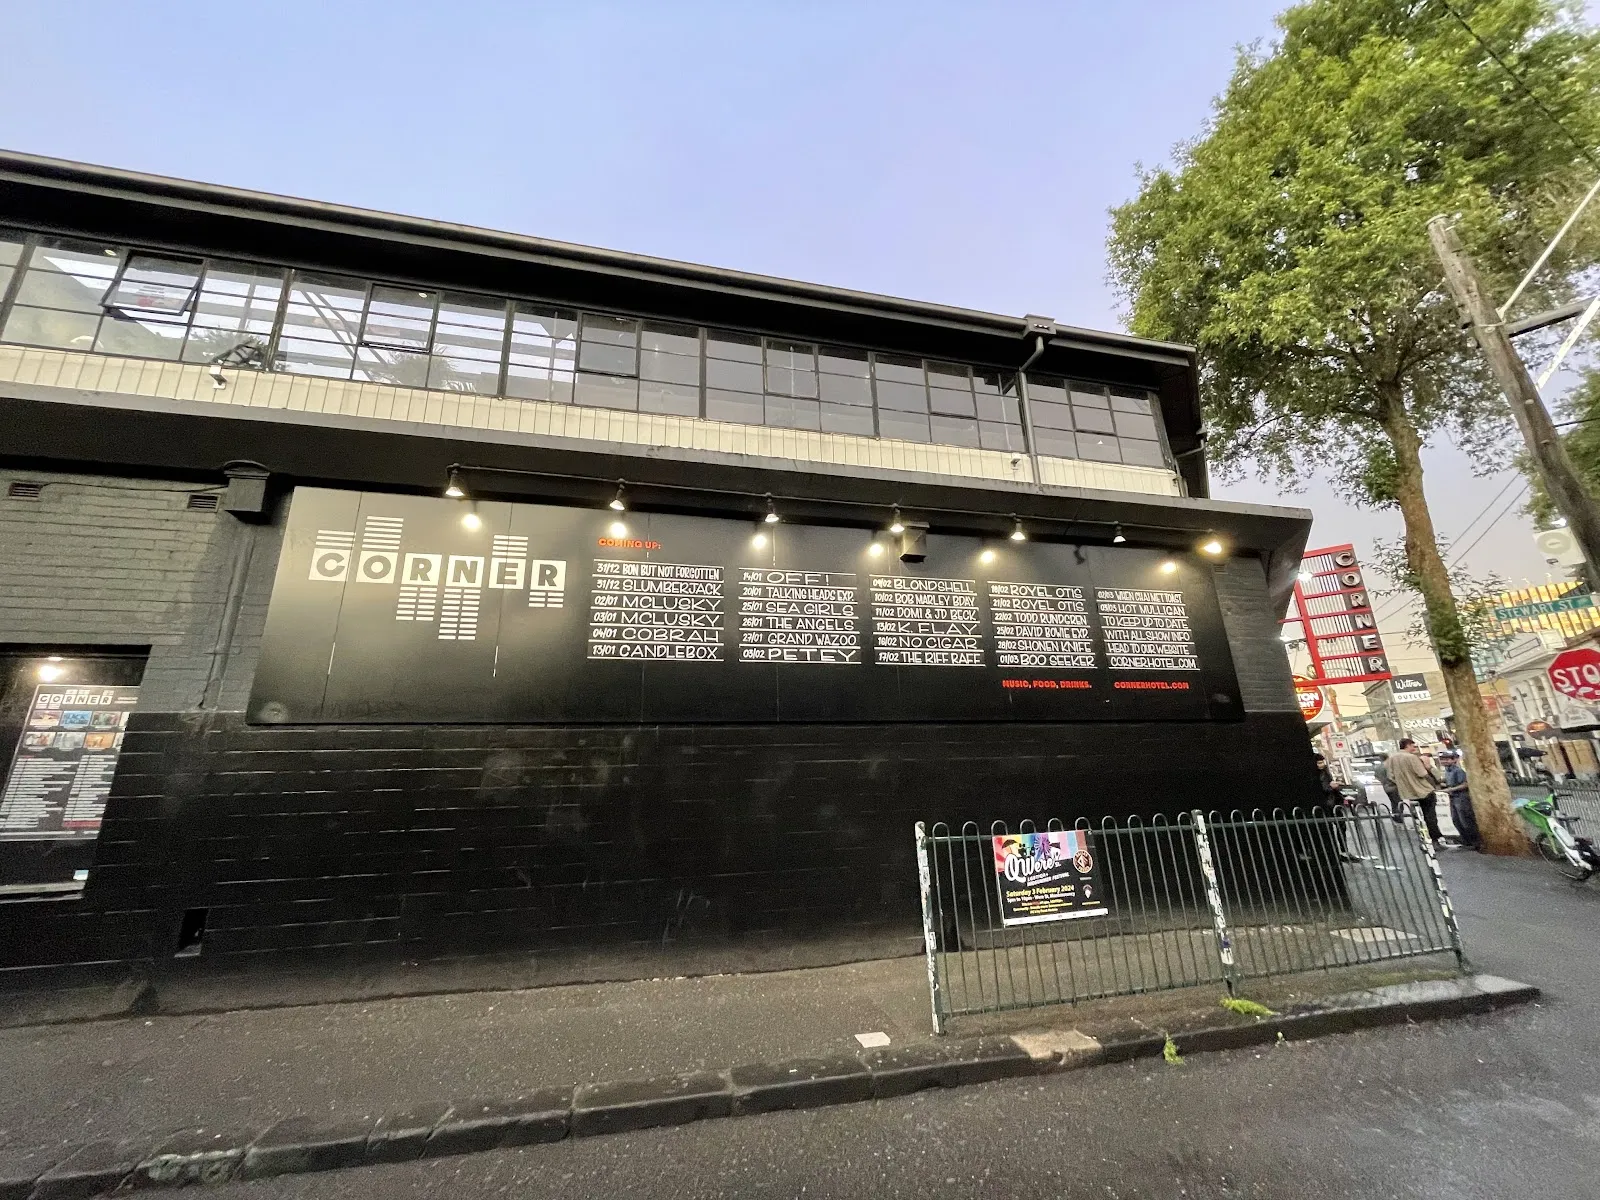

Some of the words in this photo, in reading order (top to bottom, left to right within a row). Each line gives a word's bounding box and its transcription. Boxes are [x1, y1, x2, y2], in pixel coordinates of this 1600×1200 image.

[598, 538, 643, 548] COMING
[645, 541, 661, 549] UP:
[313, 550, 562, 590] CORNER
[596, 563, 620, 573] 31/12
[622, 564, 639, 576] BON
[641, 564, 656, 577] BUT
[658, 566, 674, 578] NOT
[676, 567, 720, 580] FORGOTTEN
[743, 572, 762, 582] 14/01
[766, 572, 830, 586] OFF!
[894, 578, 974, 593] BLONDSHELL
[596, 580, 620, 590] 31/12
[622, 579, 722, 596] SLUMBERJACK
[743, 586, 762, 596] 20/01
[766, 587, 806, 600] TALKING
[808, 588, 836, 600] HEADS
[837, 590, 854, 602] EXP.
[1010, 584, 1052, 597] ROYEL
[1056, 588, 1082, 598] OTIS
[874, 592, 893, 602] 10/02
[895, 593, 914, 604] BOB
[915, 594, 950, 606] MARLEY
[952, 596, 974, 606] BDAY
[1114, 591, 1134, 601] WHEN
[594, 595, 618, 606] 02/01
[622, 596, 721, 612] MCLUSKY
[742, 601, 762, 611] 25/01
[766, 602, 800, 614] SEA
[804, 604, 854, 616] GIRLS
[992, 598, 1010, 608] 21/02
[1012, 598, 1054, 610] ROYEL
[1058, 601, 1084, 612] OTIS
[1118, 604, 1136, 614] HOT
[1139, 604, 1186, 616] MULLIGAN
[1499, 604, 1554, 619] STEWART
[1559, 600, 1574, 610] ST
[594, 611, 617, 622] 03/01
[621, 611, 720, 627] MCLUSKY
[876, 607, 894, 616] 11/02
[897, 607, 922, 618] DOMI
[925, 608, 932, 619] &
[934, 608, 947, 619] JD
[950, 610, 976, 620] BECK
[994, 612, 1012, 622] 22/02
[1014, 612, 1038, 623] TODD
[1040, 614, 1087, 626] RUNDGREN
[1336, 551, 1386, 673] CORNER
[742, 616, 762, 627] 26/01
[766, 617, 792, 629] THE
[796, 618, 854, 630] ANGELS
[876, 622, 896, 632] 13/02
[918, 622, 978, 635] FLAY
[1102, 616, 1116, 626] TO
[1116, 616, 1140, 626] KEEP
[1142, 618, 1153, 627] UP
[1153, 618, 1164, 628] TO
[1166, 619, 1188, 629] DATE
[592, 628, 617, 638] 04/01
[622, 628, 718, 642] COBRAH
[743, 632, 762, 642] 27/01
[768, 632, 812, 644] GRAND
[815, 634, 856, 646] WAZOO
[996, 626, 1014, 635] 25/02
[1016, 626, 1042, 637] DAVID
[1045, 628, 1070, 638] BOWIE
[1072, 628, 1089, 638] EXP.
[1104, 630, 1129, 640] WITH
[1130, 630, 1146, 640] ALL
[1146, 631, 1170, 640] SHOW
[1170, 632, 1190, 641] INFO
[899, 636, 922, 648] NO
[926, 637, 978, 650] CIGAR
[1018, 640, 1059, 652] SHONEN
[1061, 642, 1092, 652] KNIFE
[1108, 642, 1130, 653] HEAD
[1130, 644, 1140, 654] TO
[1141, 644, 1156, 654] OUR
[1156, 644, 1190, 654] WEBSITE
[592, 644, 616, 656] 13/01
[619, 644, 718, 659] CANDLEBOX
[768, 648, 856, 662] PETEY
[879, 652, 899, 662] 17/02
[900, 652, 922, 663] THE
[925, 652, 948, 664] RIFF
[950, 653, 980, 664] RAFF
[1020, 654, 1046, 666] BOO
[1050, 655, 1094, 666] SEEKER
[1110, 656, 1196, 668] CORNERHOTEL.COM
[1553, 663, 1600, 688] STO
[1002, 680, 1032, 688] MUSIC,
[1032, 680, 1058, 689] FOOD,
[1060, 680, 1092, 688] DRINKS.
[39, 695, 110, 704] CORNER
[1006, 889, 1031, 898] Saturday
[1036, 886, 1060, 894] February
[1061, 884, 1074, 892] 2024
